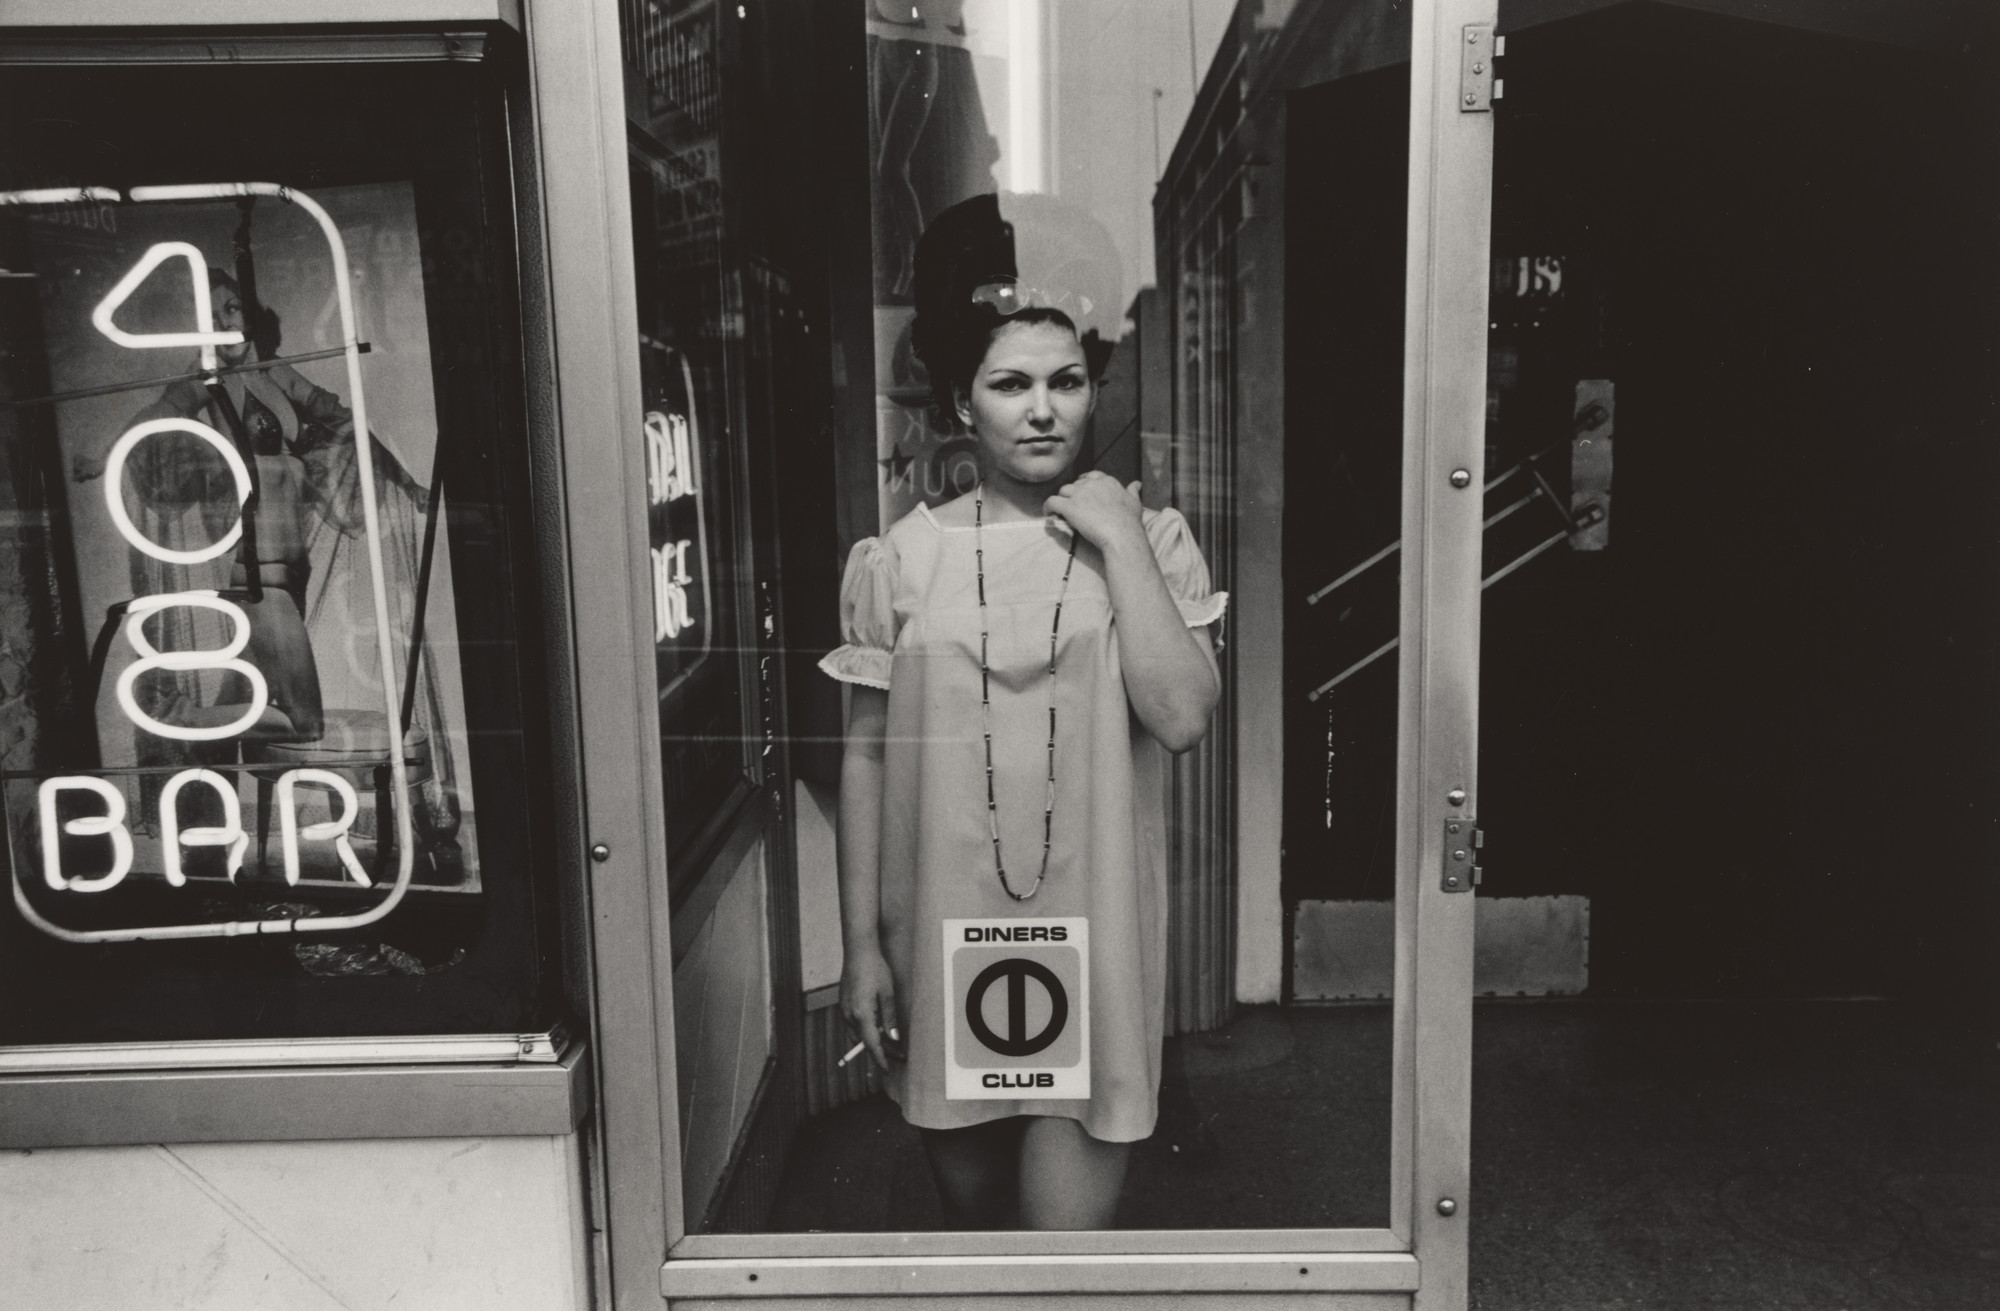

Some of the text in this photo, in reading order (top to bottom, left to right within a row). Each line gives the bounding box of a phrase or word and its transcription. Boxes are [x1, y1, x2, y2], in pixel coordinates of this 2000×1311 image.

[92, 241, 268, 741] 408
[38, 768, 373, 892] BAR
[964, 926, 1068, 942] DINERS
[982, 1073, 1054, 1088] CLUB
